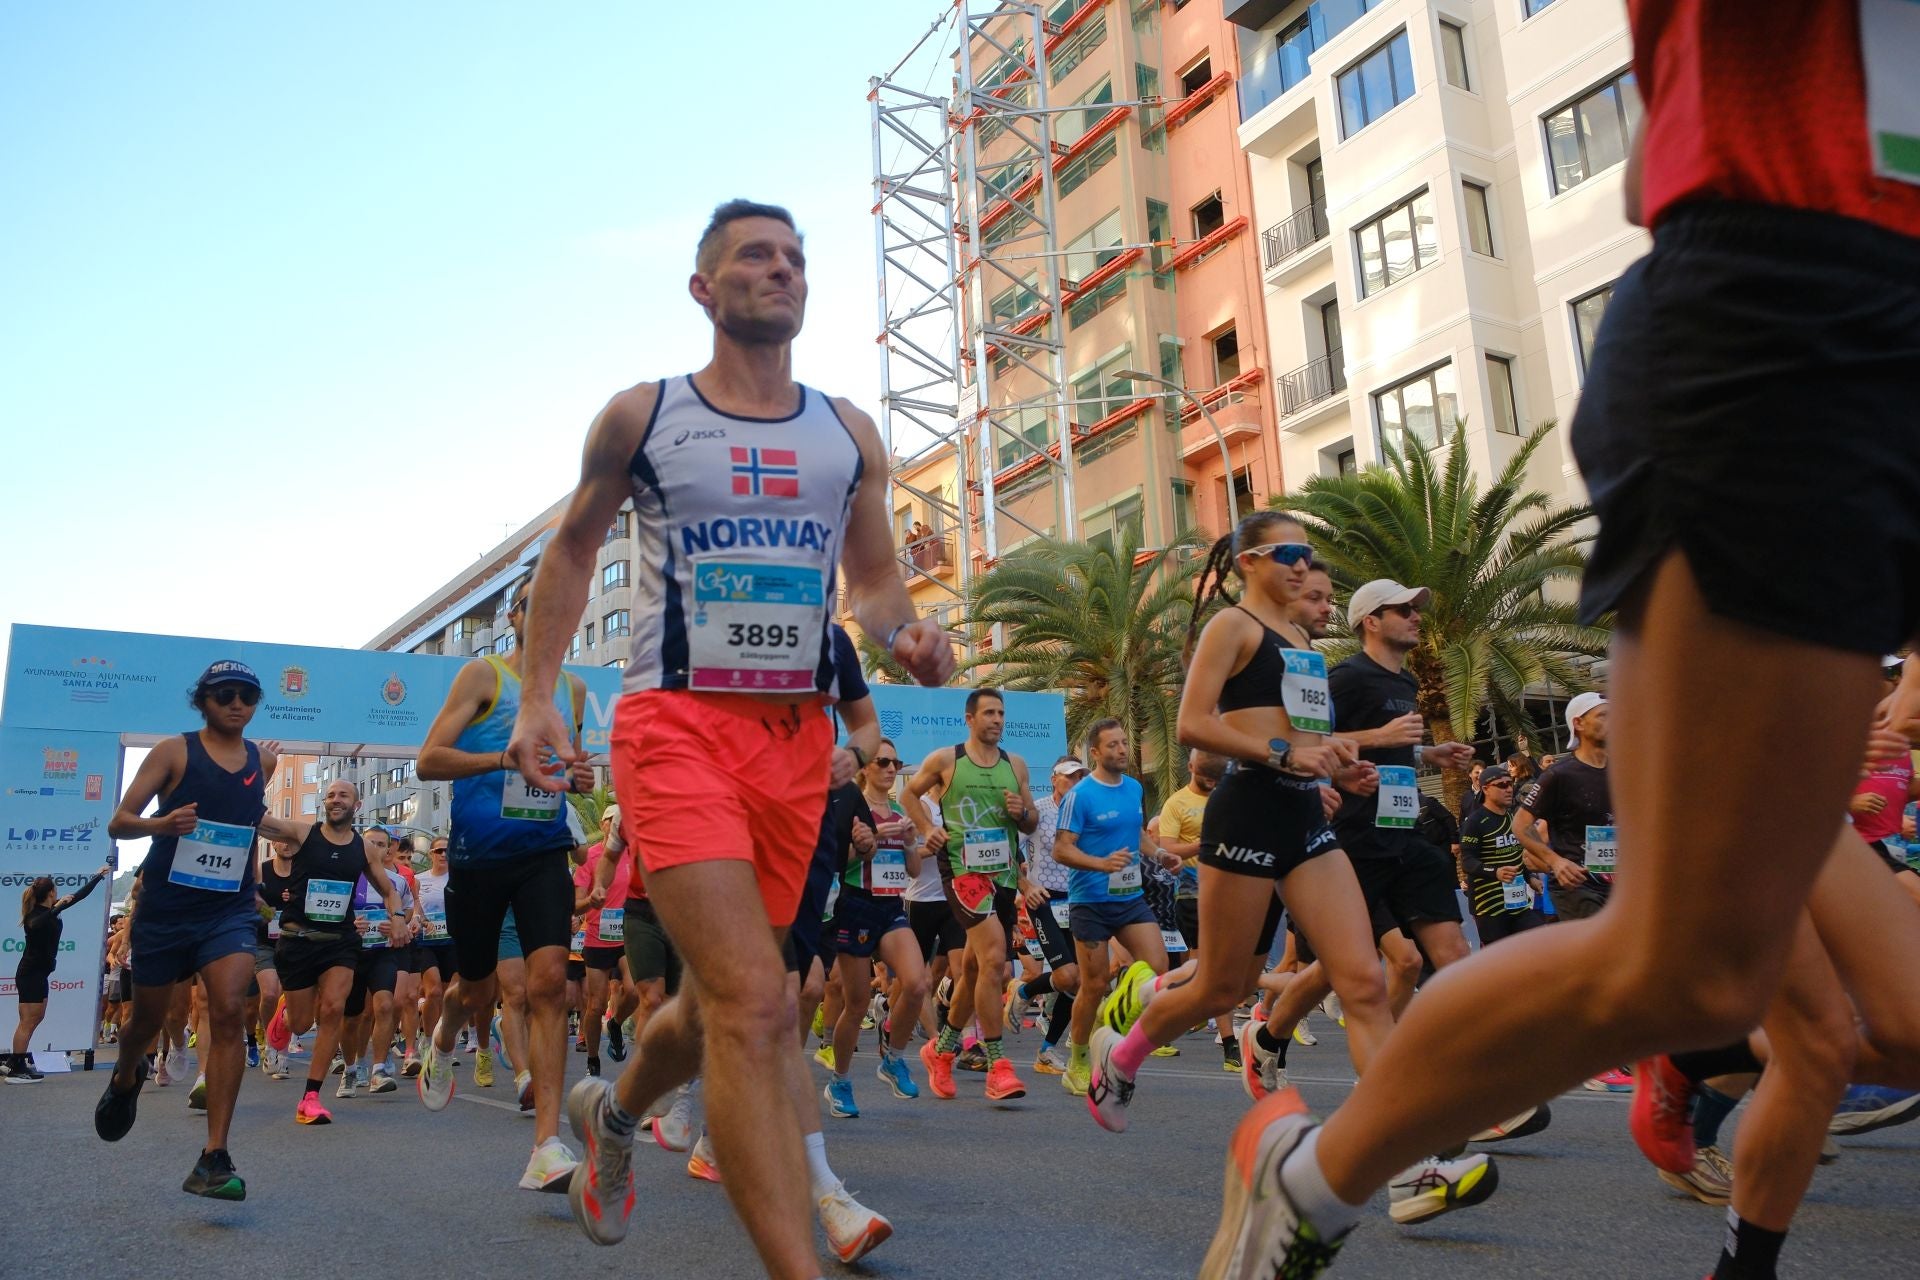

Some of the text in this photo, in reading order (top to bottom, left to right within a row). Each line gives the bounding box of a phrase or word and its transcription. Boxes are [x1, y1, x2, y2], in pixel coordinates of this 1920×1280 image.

[692, 428, 726, 440] asics
[681, 518, 832, 555] NORWAY
[727, 623, 799, 647] 3895
[24, 668, 158, 684] AYUNTAMIENTO AJUNTAMENT
[63, 679, 119, 689] SANTA POLA
[1301, 688, 1326, 706] 1682
[264, 703, 322, 714] Ayuntamiento
[270, 712, 315, 721] de Alicante
[1005, 721, 1051, 730] GENERALITAT
[1006, 730, 1051, 738] VALENCIANA
[1393, 795, 1413, 808] 3192
[5, 842, 90, 851] Asistencia
[1495, 833, 1520, 849] ELC
[978, 849, 1000, 858] 3015
[1215, 843, 1276, 867] NIKE
[196, 853, 232, 869] 4114
[882, 871, 905, 880] 4330
[316, 899, 341, 909] 2975
[50, 980, 85, 991] Sport
